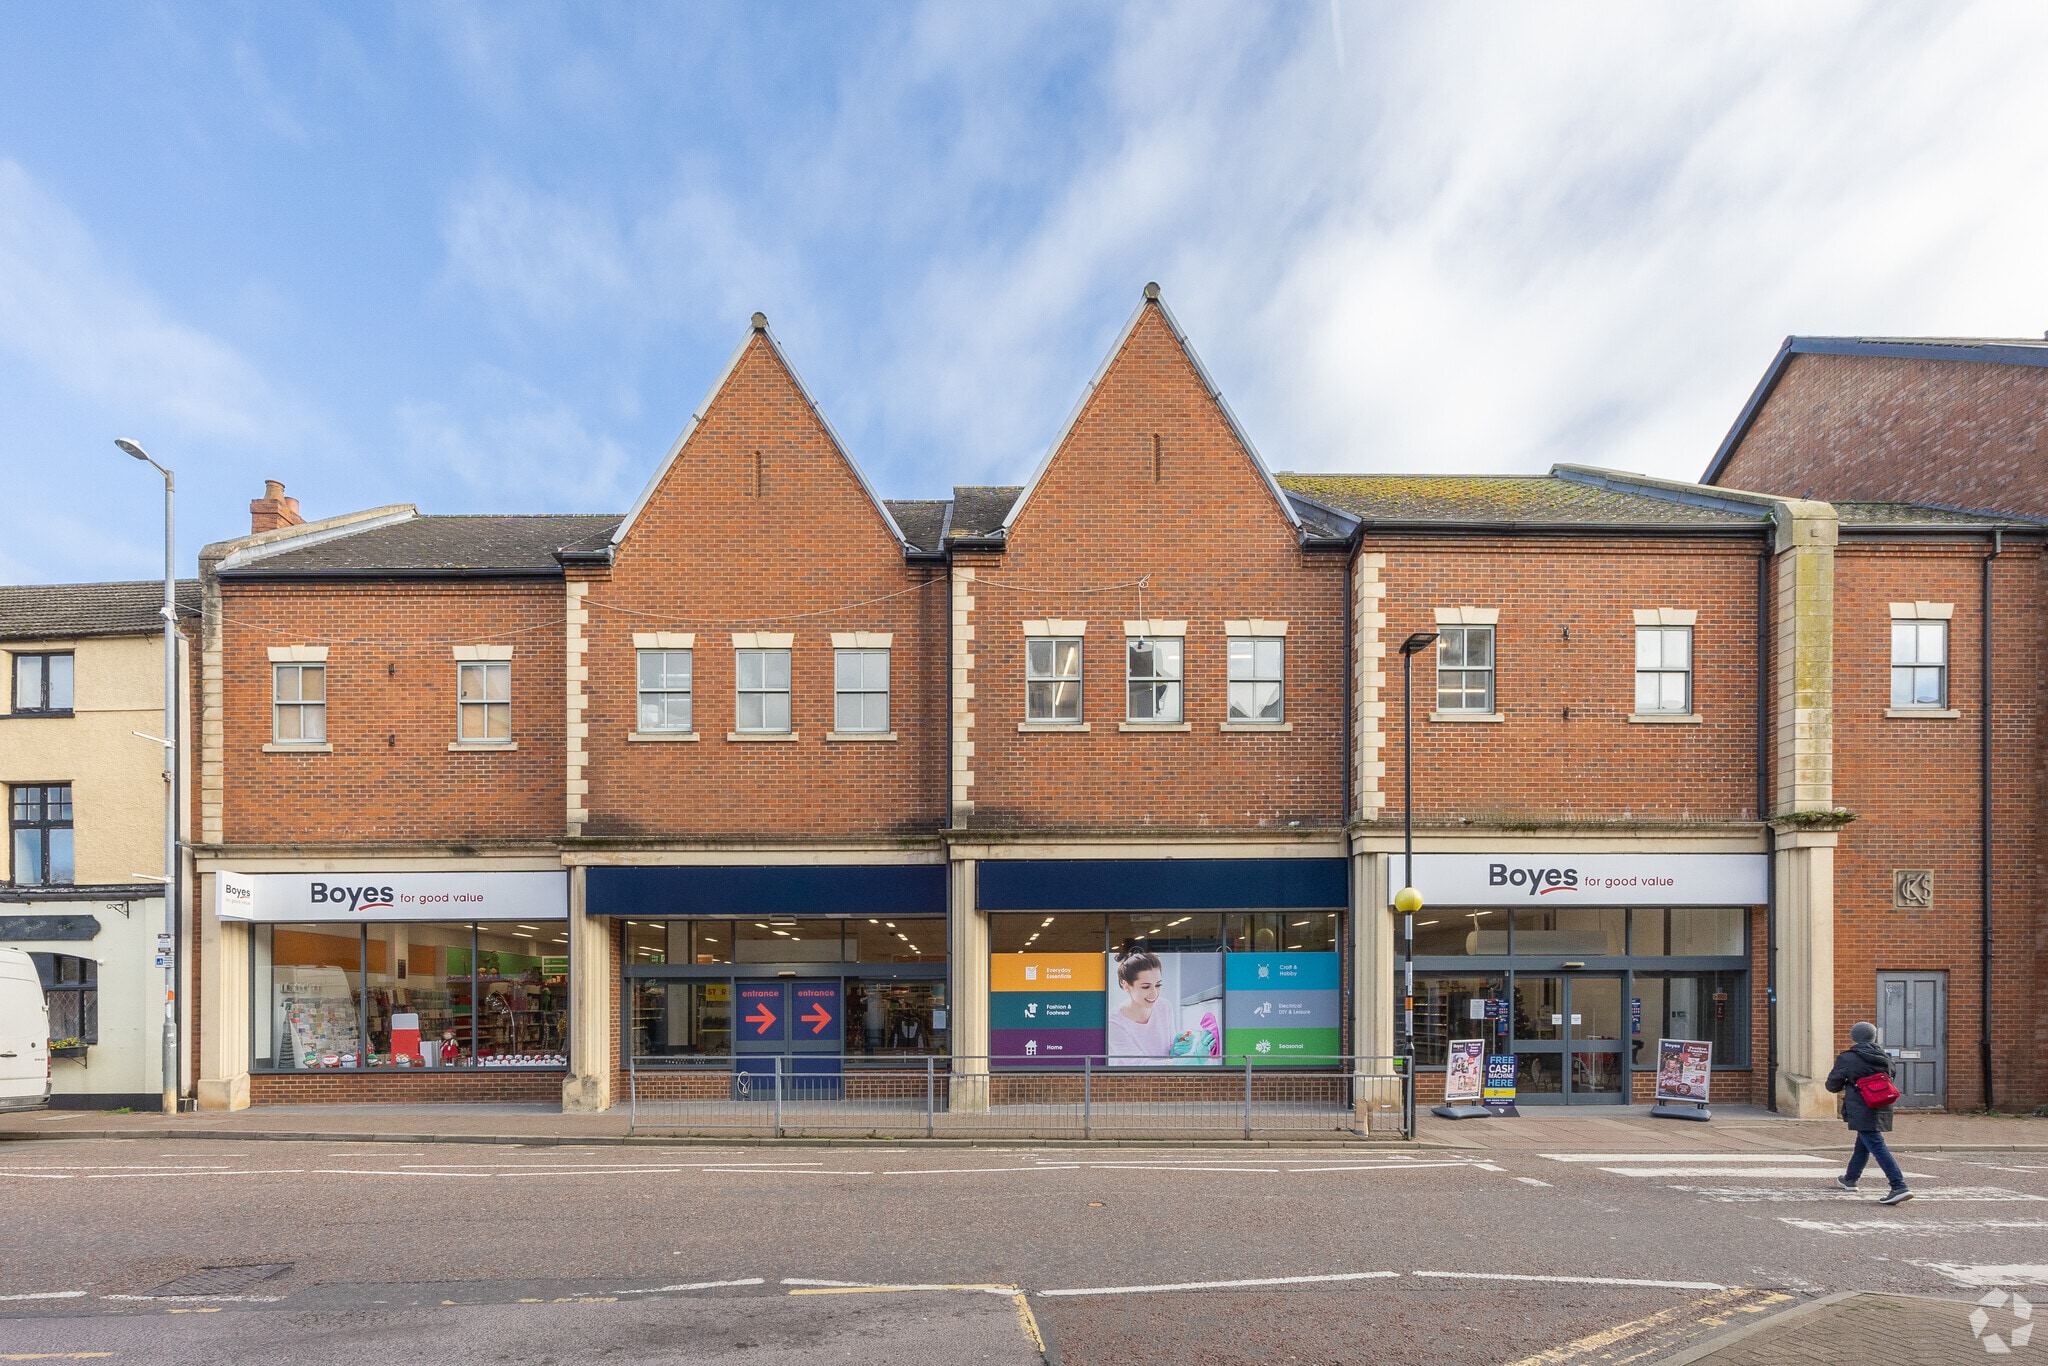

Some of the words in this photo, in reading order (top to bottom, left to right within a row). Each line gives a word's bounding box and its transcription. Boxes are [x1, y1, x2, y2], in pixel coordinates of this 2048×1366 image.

[1489, 864, 1578, 895] Boyes
[1585, 876, 1601, 887] for
[1605, 876, 1637, 889] good
[1641, 876, 1674, 887] value
[225, 884, 251, 899] Boyes
[311, 882, 394, 912] Boyes
[400, 893, 415, 903] for
[419, 893, 449, 905] good
[453, 893, 484, 903] value
[742, 990, 779, 998] entrance
[797, 989, 835, 997] entrance
[1490, 1056, 1515, 1064] FREE
[1488, 1064, 1515, 1073] CASH
[1487, 1079, 1514, 1087] HERE
